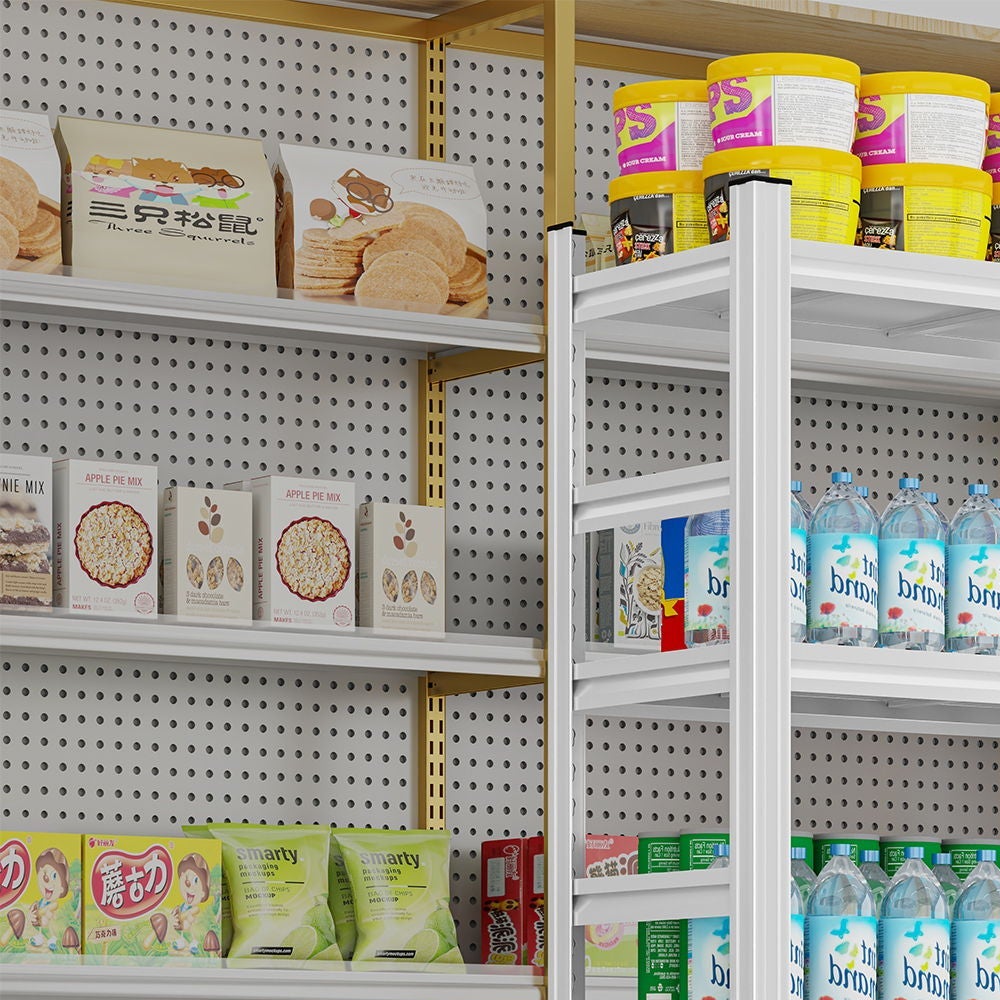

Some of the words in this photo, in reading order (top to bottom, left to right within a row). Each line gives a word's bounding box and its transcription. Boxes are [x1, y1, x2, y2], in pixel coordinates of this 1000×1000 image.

[868, 148, 896, 156] CREAM
[89, 200, 259, 235] 三只松鼠
[88, 219, 152, 236] Three
[159, 226, 256, 246] Squirrels
[0, 478, 20, 493] NIE
[26, 480, 45, 495] MIX
[85, 473, 110, 485] APPLE
[113, 475, 125, 486] PIE
[128, 476, 143, 487] MIX
[286, 489, 310, 500] APPLE
[313, 491, 324, 501] PIE
[327, 492, 341, 502] MIX
[236, 847, 298, 864] smarty
[360, 851, 420, 869] smarty
